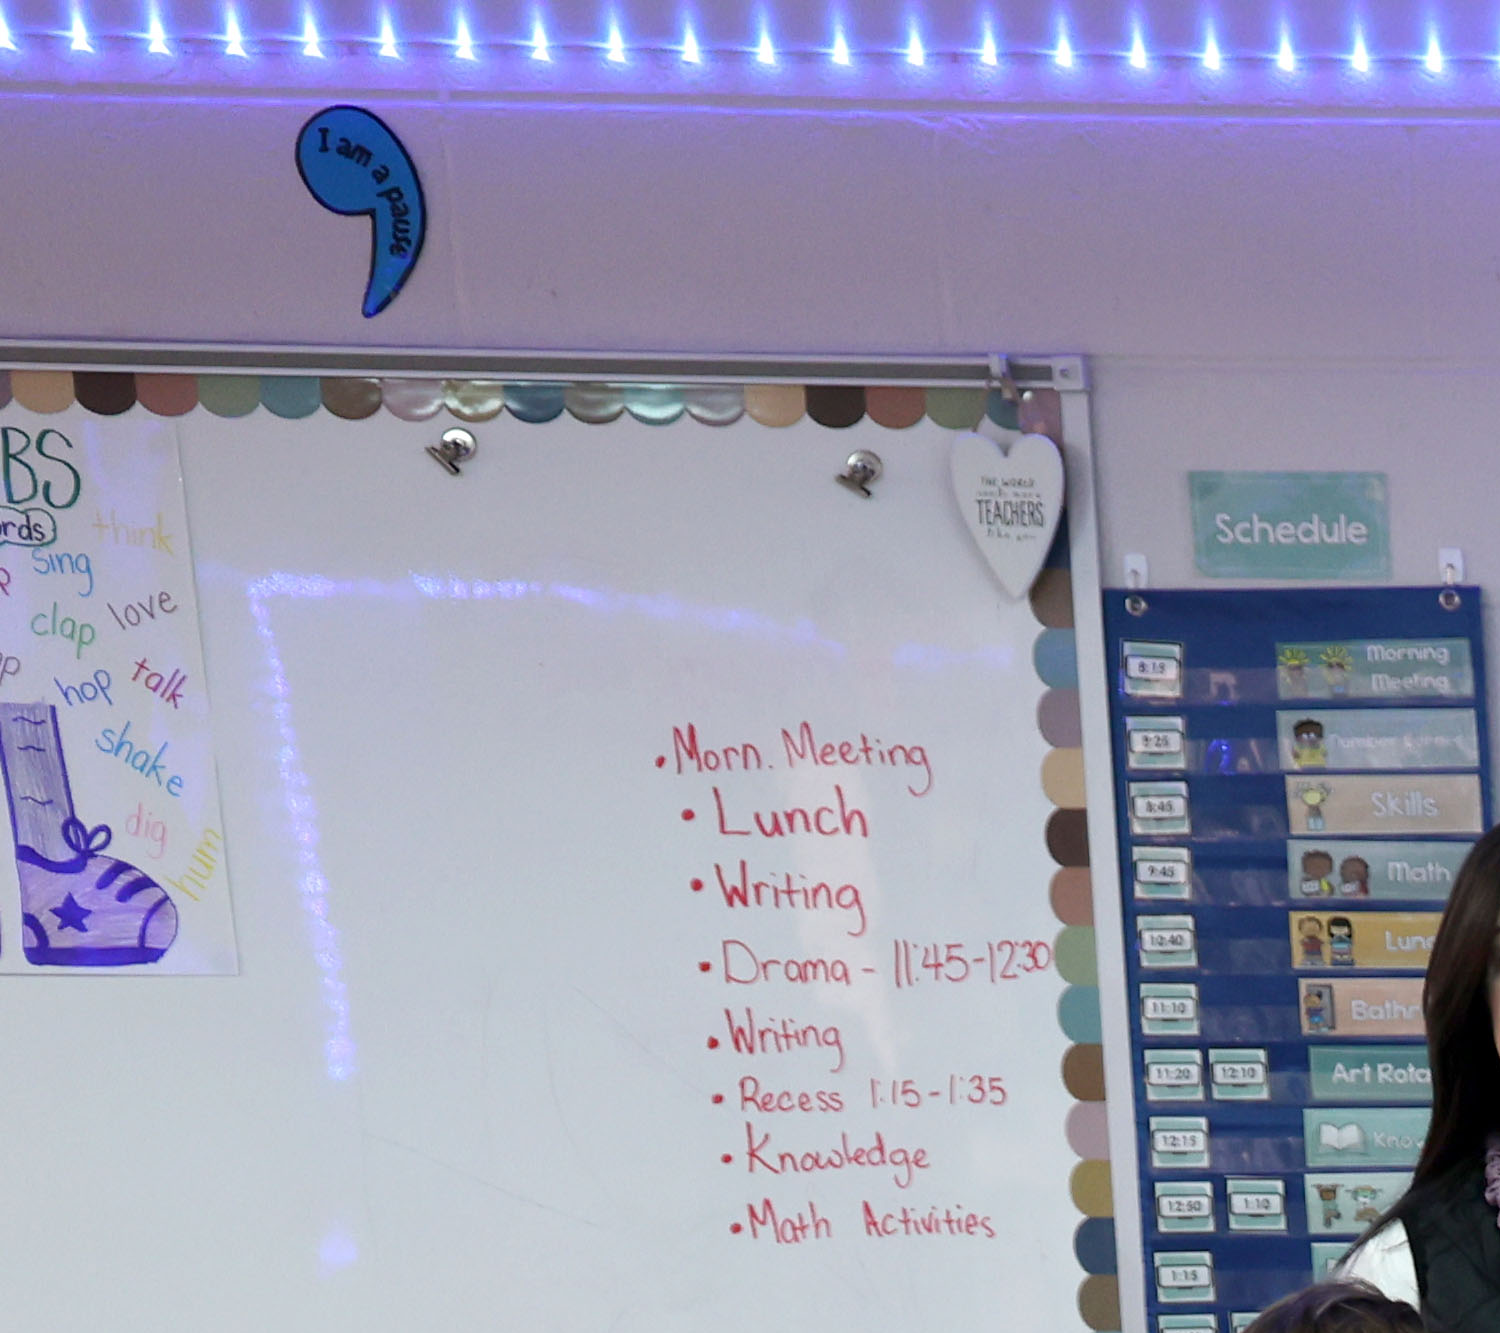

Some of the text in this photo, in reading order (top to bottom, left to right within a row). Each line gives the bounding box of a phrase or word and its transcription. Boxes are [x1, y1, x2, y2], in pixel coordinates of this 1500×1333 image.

[318, 127, 412, 259] I am a pause
[0, 513, 46, 542] rds
[93, 507, 174, 554] think
[975, 498, 1044, 528] TEACHERS
[1215, 514, 1369, 545] Schedule
[30, 601, 95, 660] clap
[107, 590, 179, 631] love
[1366, 645, 1451, 666] Morning
[53, 669, 114, 707] hop
[131, 657, 188, 710] talk
[1371, 672, 1449, 696] Meeting
[94, 720, 184, 797] shake
[673, 722, 930, 800] Morn. Meeting
[713, 785, 869, 838] Lunch
[1371, 792, 1439, 817] Skills
[125, 801, 167, 859] dig
[164, 827, 223, 902] hum
[1387, 862, 1452, 883] Math
[715, 860, 867, 936] Writing
[722, 938, 851, 985] Drama
[1385, 931, 1435, 951] Lunc
[1351, 1000, 1424, 1021] Bathr
[723, 1006, 845, 1073] Writing
[739, 1075, 844, 1112] Recess
[1332, 1063, 1432, 1084] Art Rota
[745, 1121, 930, 1188] Knowledge
[747, 1197, 997, 1244] Math Activities
